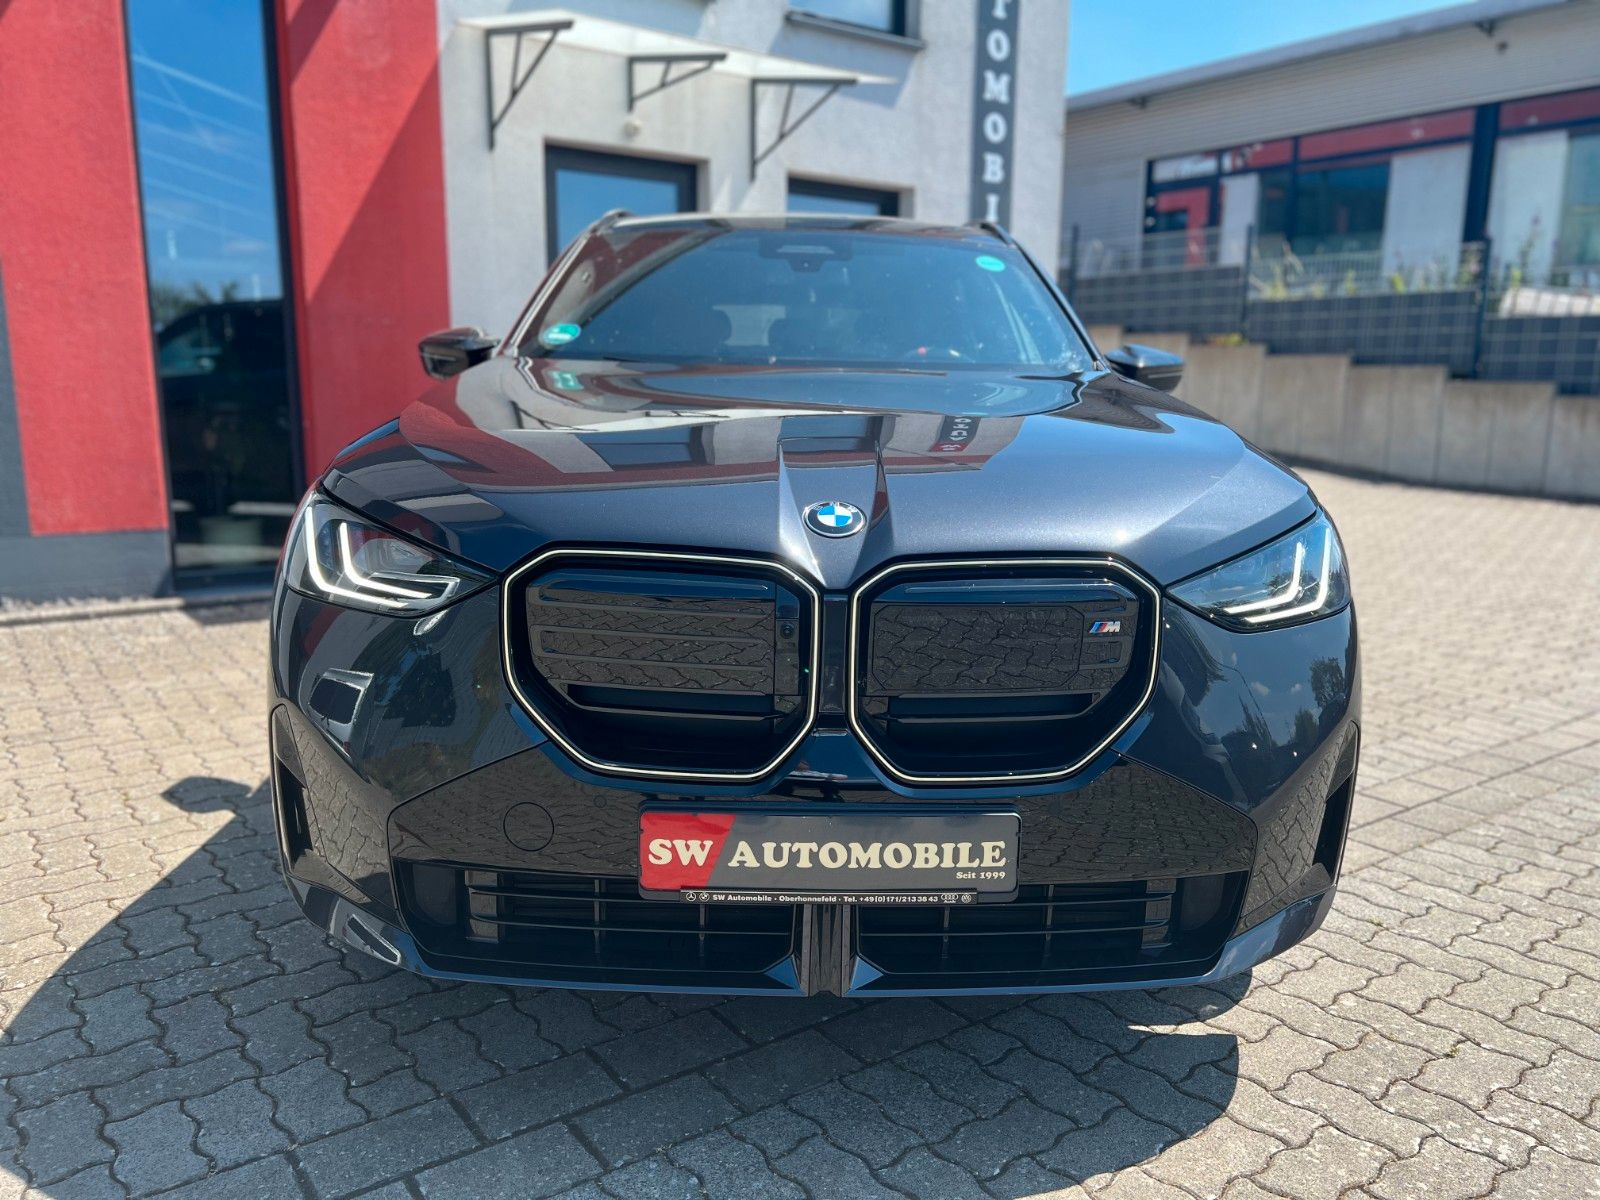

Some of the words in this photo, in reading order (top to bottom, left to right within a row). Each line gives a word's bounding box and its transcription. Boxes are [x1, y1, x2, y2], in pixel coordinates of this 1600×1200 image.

[648, 838, 713, 867] SW
[728, 840, 1006, 869] AUTOMOBILE
[955, 871, 977, 880] Seit
[979, 871, 1006, 880] 1999
[727, 894, 772, 902] Automobile
[778, 895, 837, 903] Oberhonnefeld
[842, 895, 858, 903] Tel.
